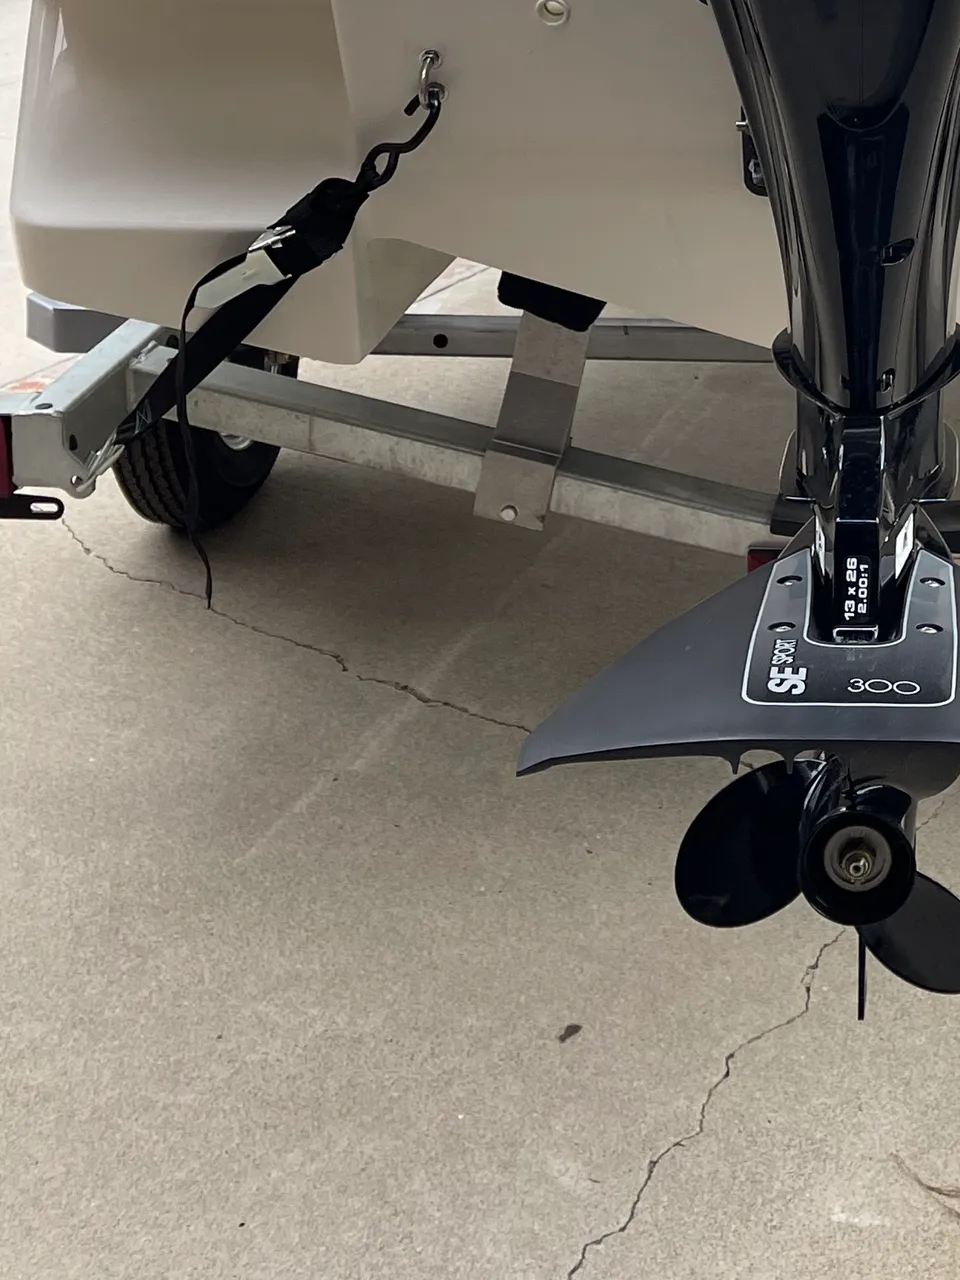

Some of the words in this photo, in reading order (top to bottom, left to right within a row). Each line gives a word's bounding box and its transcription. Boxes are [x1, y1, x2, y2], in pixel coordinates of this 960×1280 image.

[846, 558, 857, 582] 26
[848, 587, 857, 595] x
[857, 564, 869, 614] 2.00:1
[844, 600, 855, 620] 13
[771, 639, 798, 665] SPORT
[767, 666, 807, 695] SE
[847, 678, 921, 695] 300
